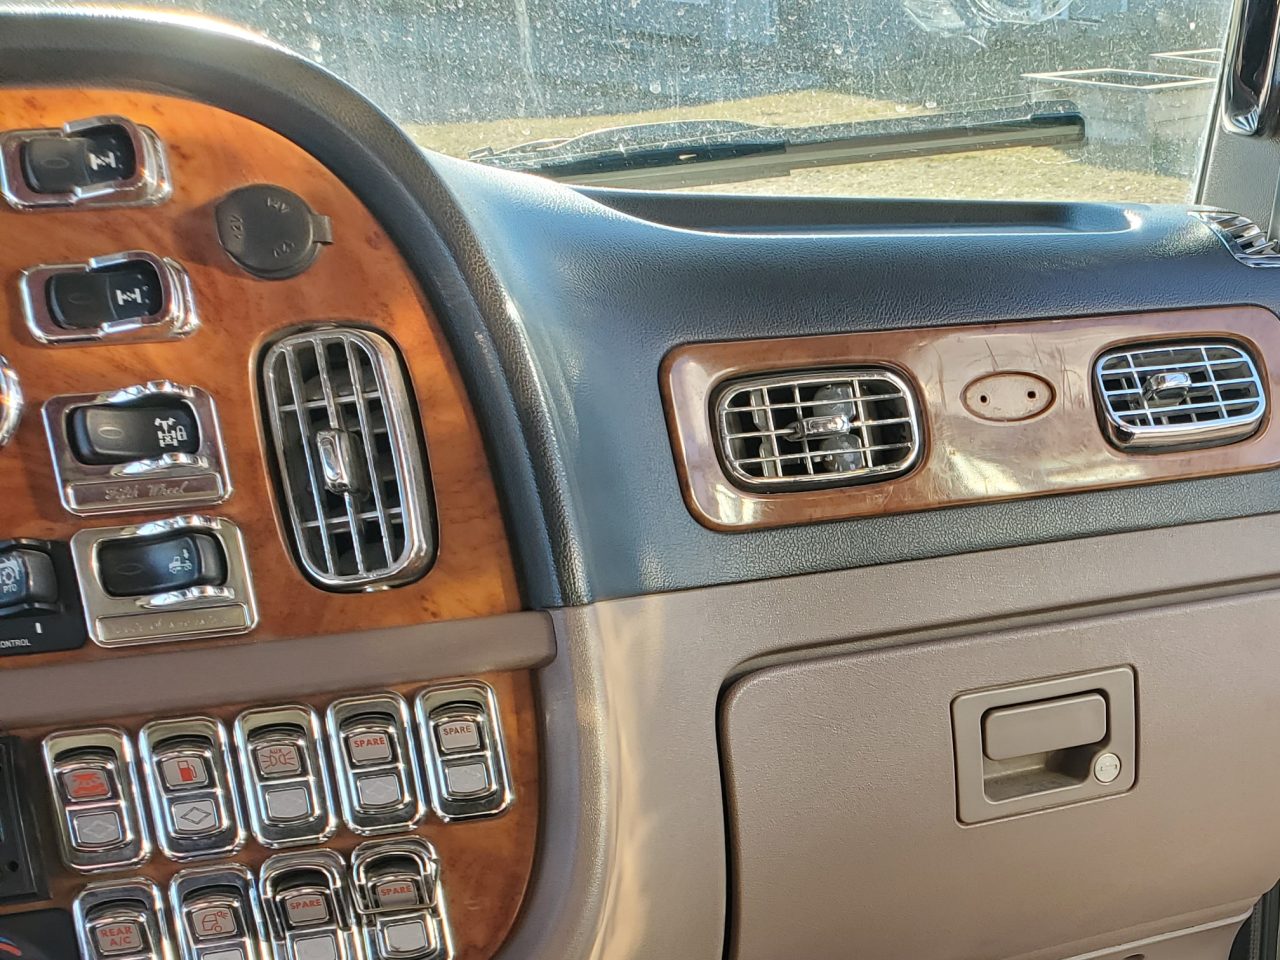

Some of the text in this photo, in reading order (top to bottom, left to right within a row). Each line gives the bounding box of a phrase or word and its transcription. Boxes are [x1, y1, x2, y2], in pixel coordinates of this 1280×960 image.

[3, 583, 18, 593] PTO
[0, 638, 32, 649] ONTROL
[443, 725, 472, 736] SPARE
[353, 736, 386, 748] SPARE
[380, 885, 412, 896] SPARE
[289, 899, 322, 910] SPARE
[100, 926, 133, 938] REAR
[109, 936, 132, 947] A/C
